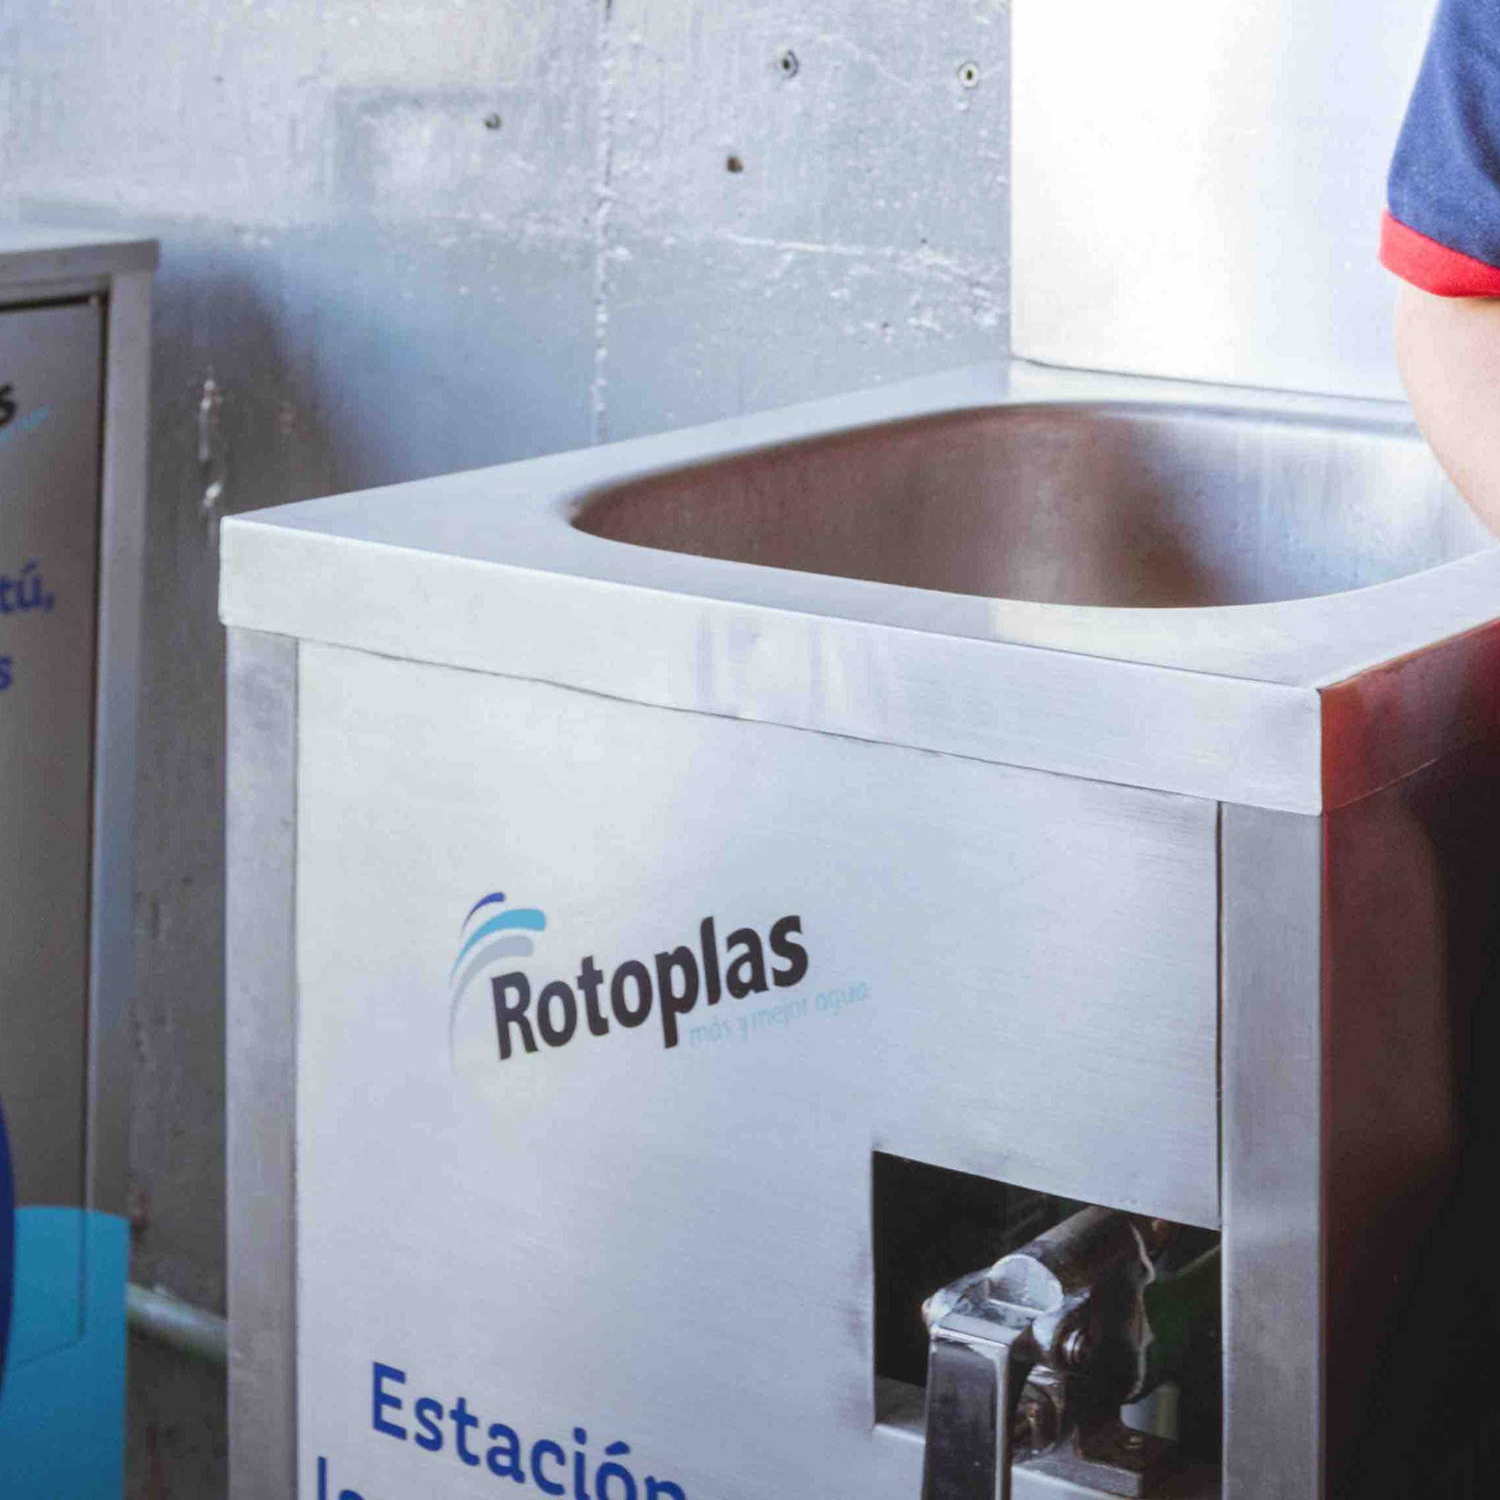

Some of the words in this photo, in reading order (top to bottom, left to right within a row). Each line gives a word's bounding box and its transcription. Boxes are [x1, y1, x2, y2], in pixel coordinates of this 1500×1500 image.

[491, 915, 809, 1061] Rotoplas
[688, 1016, 733, 1047] más
[751, 997, 810, 1034] mejor
[814, 981, 869, 1016] agua
